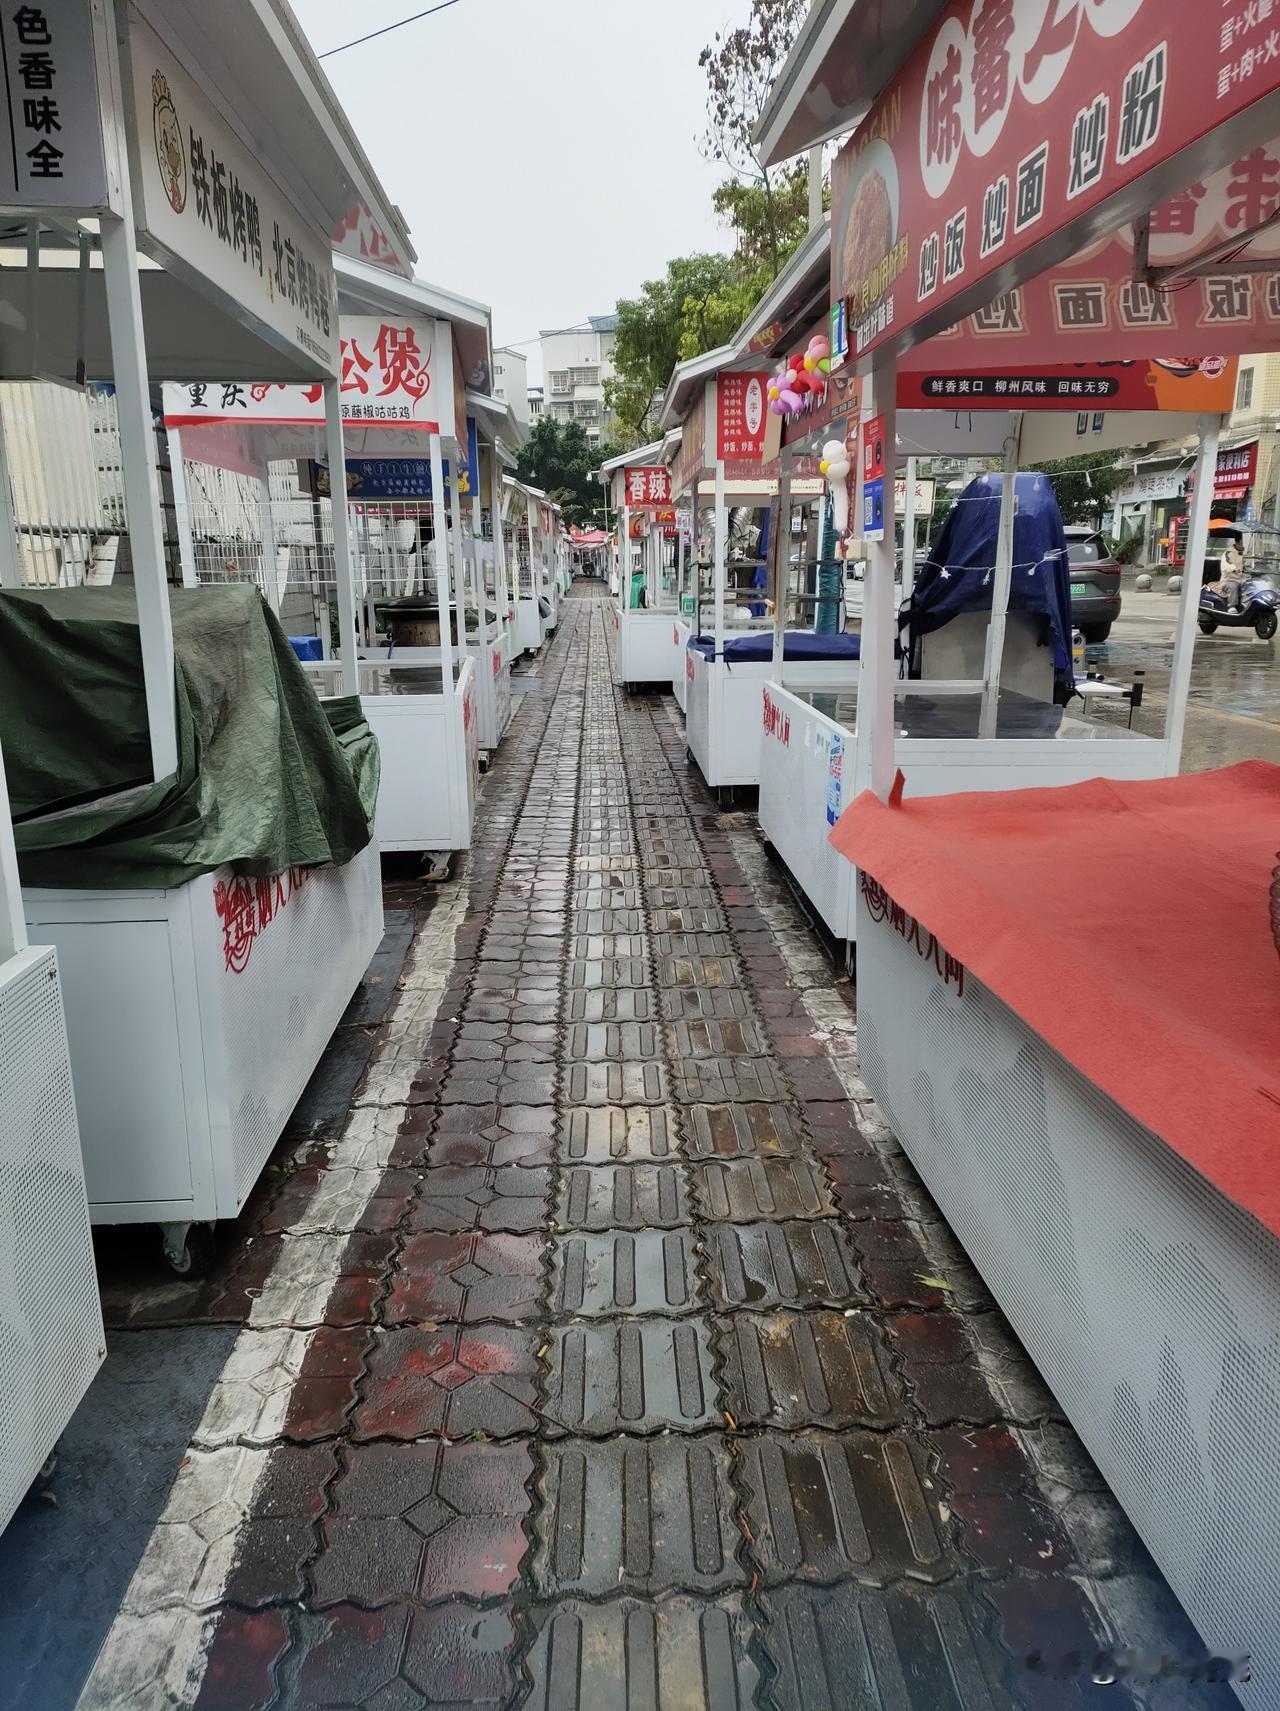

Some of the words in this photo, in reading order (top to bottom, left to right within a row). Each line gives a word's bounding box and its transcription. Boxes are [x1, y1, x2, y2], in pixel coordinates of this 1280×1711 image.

[1219, 0, 1279, 53] 蛋+火腿
[13, 5, 64, 178] 色香味全
[918, 206, 967, 302] 炒饭
[980, 141, 1048, 260] 炒面
[1066, 40, 1168, 200] 炒粉
[189, 125, 263, 278] 铁板烤鸭
[931, 380, 984, 393] 鲜香爽口
[994, 380, 1047, 393] 柳州风味
[1057, 380, 1110, 393] 回味无穷
[629, 470, 672, 501] 香辣
[1216, 451, 1250, 471] 家便利店
